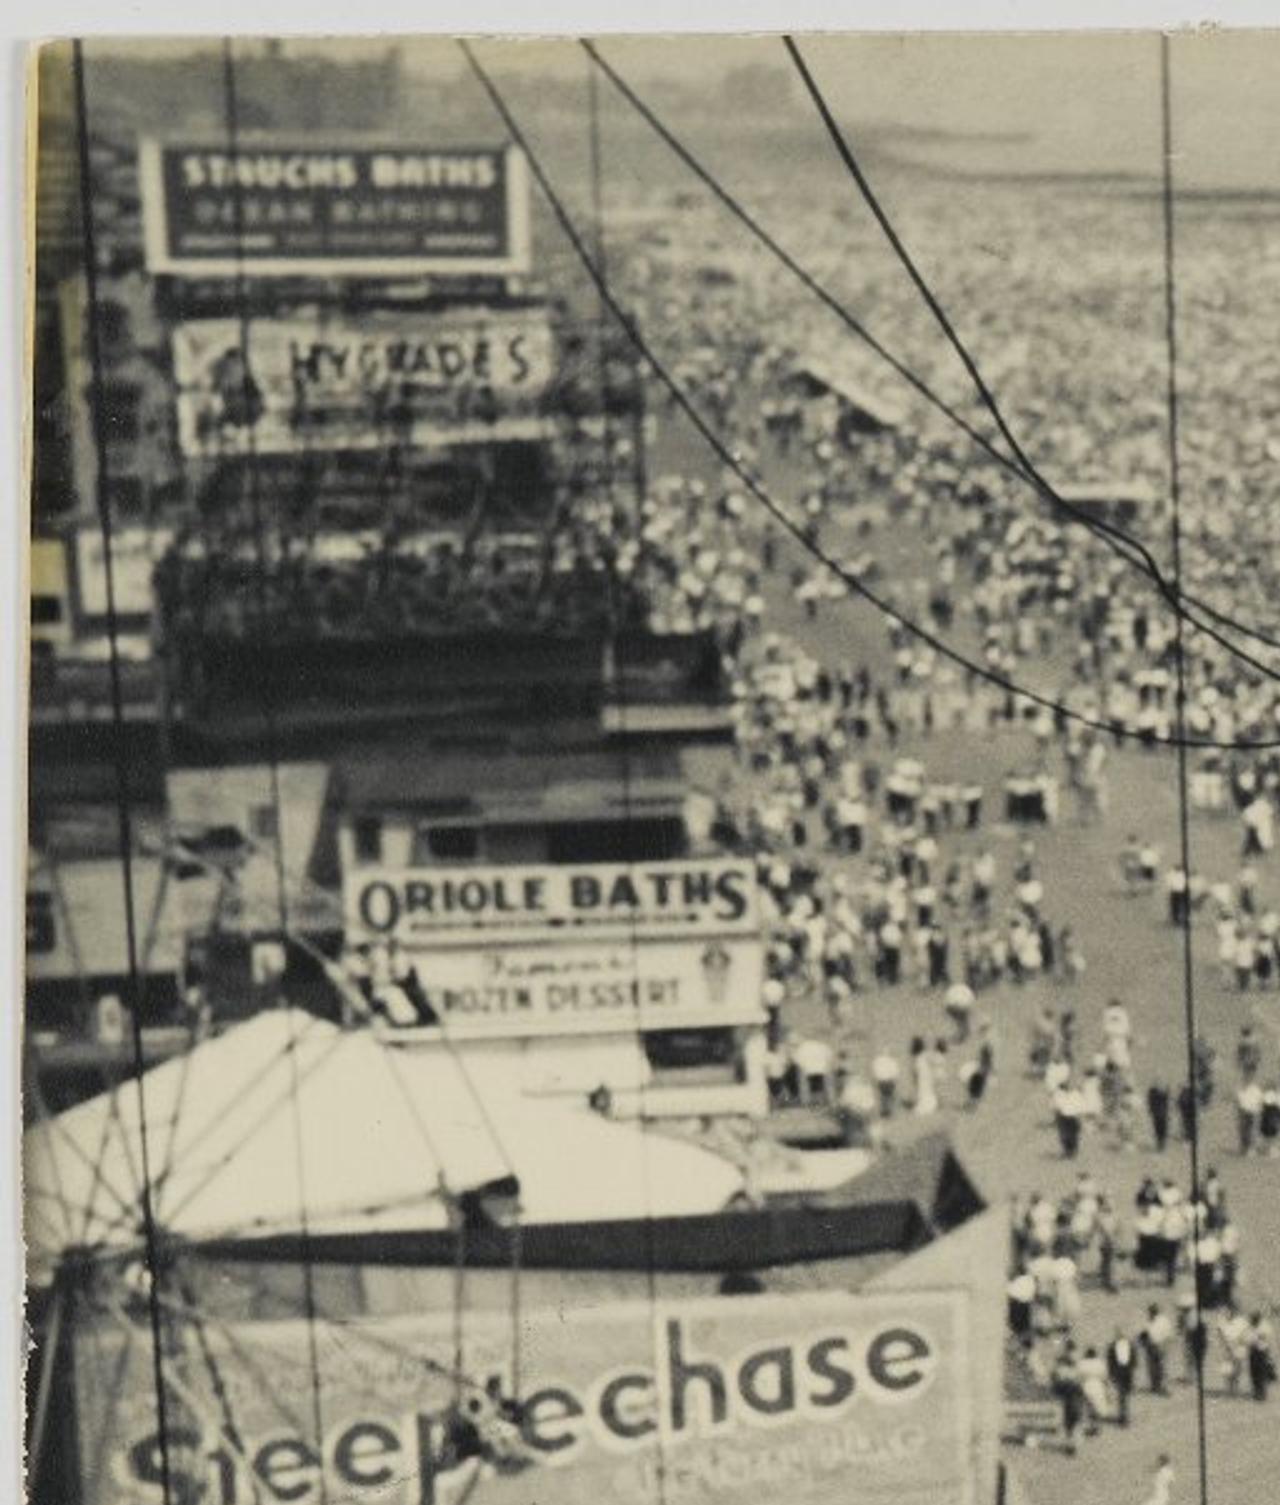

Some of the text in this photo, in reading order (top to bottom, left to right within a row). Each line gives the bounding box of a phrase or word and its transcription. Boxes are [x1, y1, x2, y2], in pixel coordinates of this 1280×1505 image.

[371, 155, 496, 188] BATHS
[359, 869, 748, 934] ORIOLE BATHS
